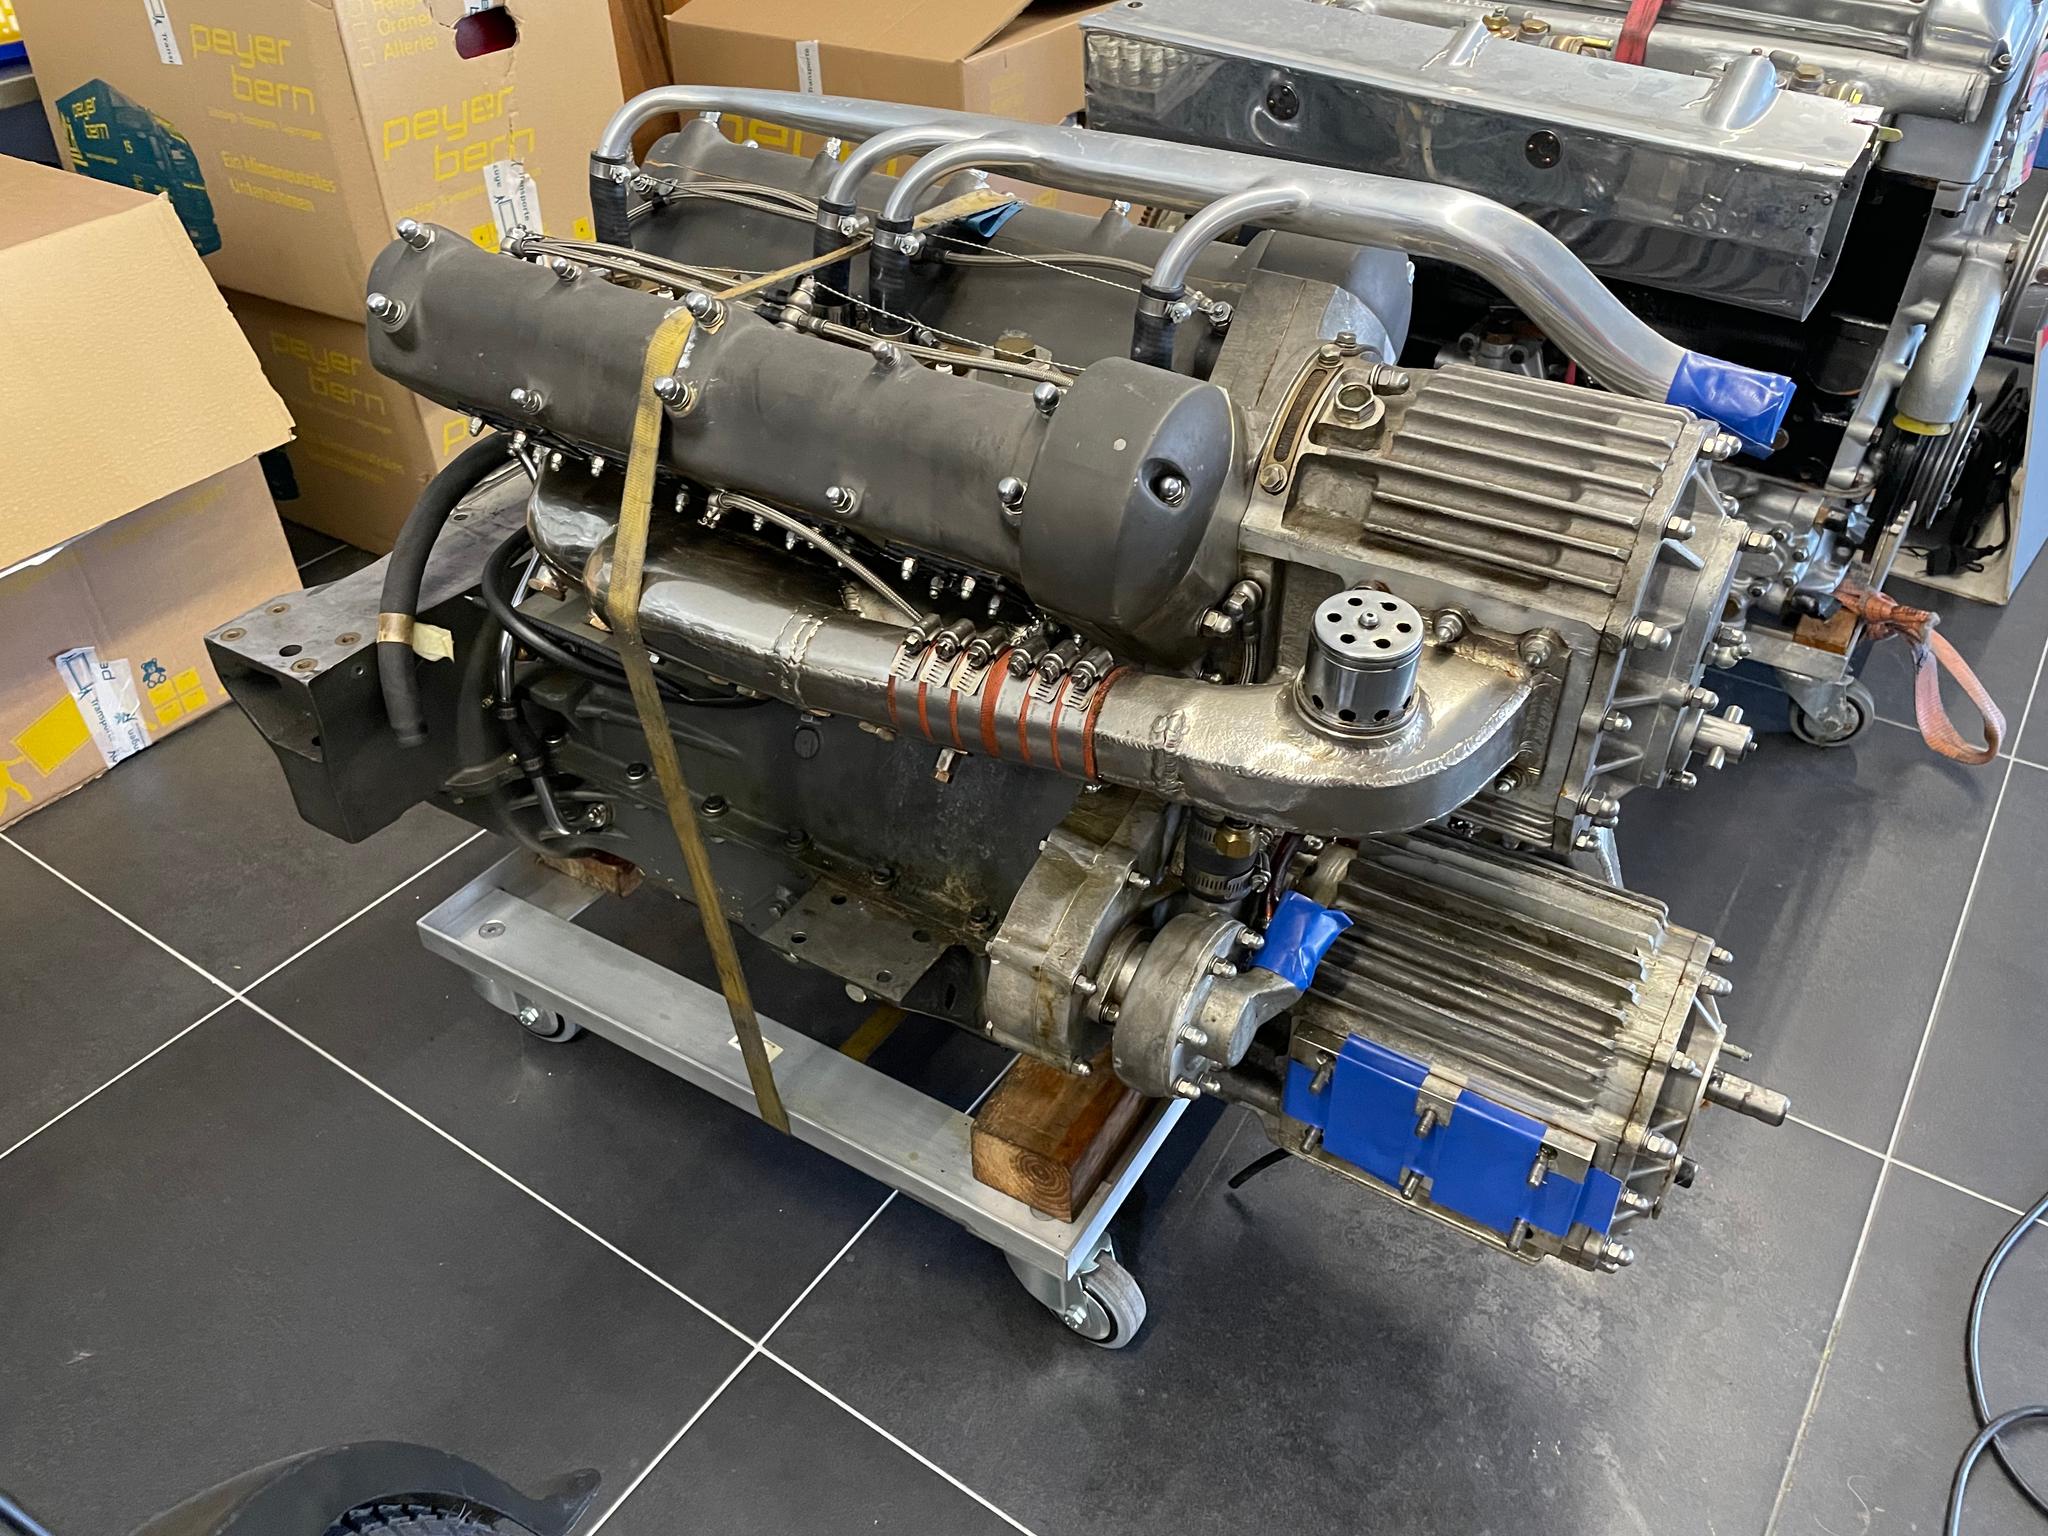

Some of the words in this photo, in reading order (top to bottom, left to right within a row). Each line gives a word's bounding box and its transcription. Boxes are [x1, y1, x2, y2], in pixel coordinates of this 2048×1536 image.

[190, 23, 292, 68] peyer
[231, 68, 315, 115] bern
[382, 85, 516, 162] peyer
[432, 127, 536, 182] bern
[270, 332, 363, 377] peyer
[308, 366, 387, 417] bern
